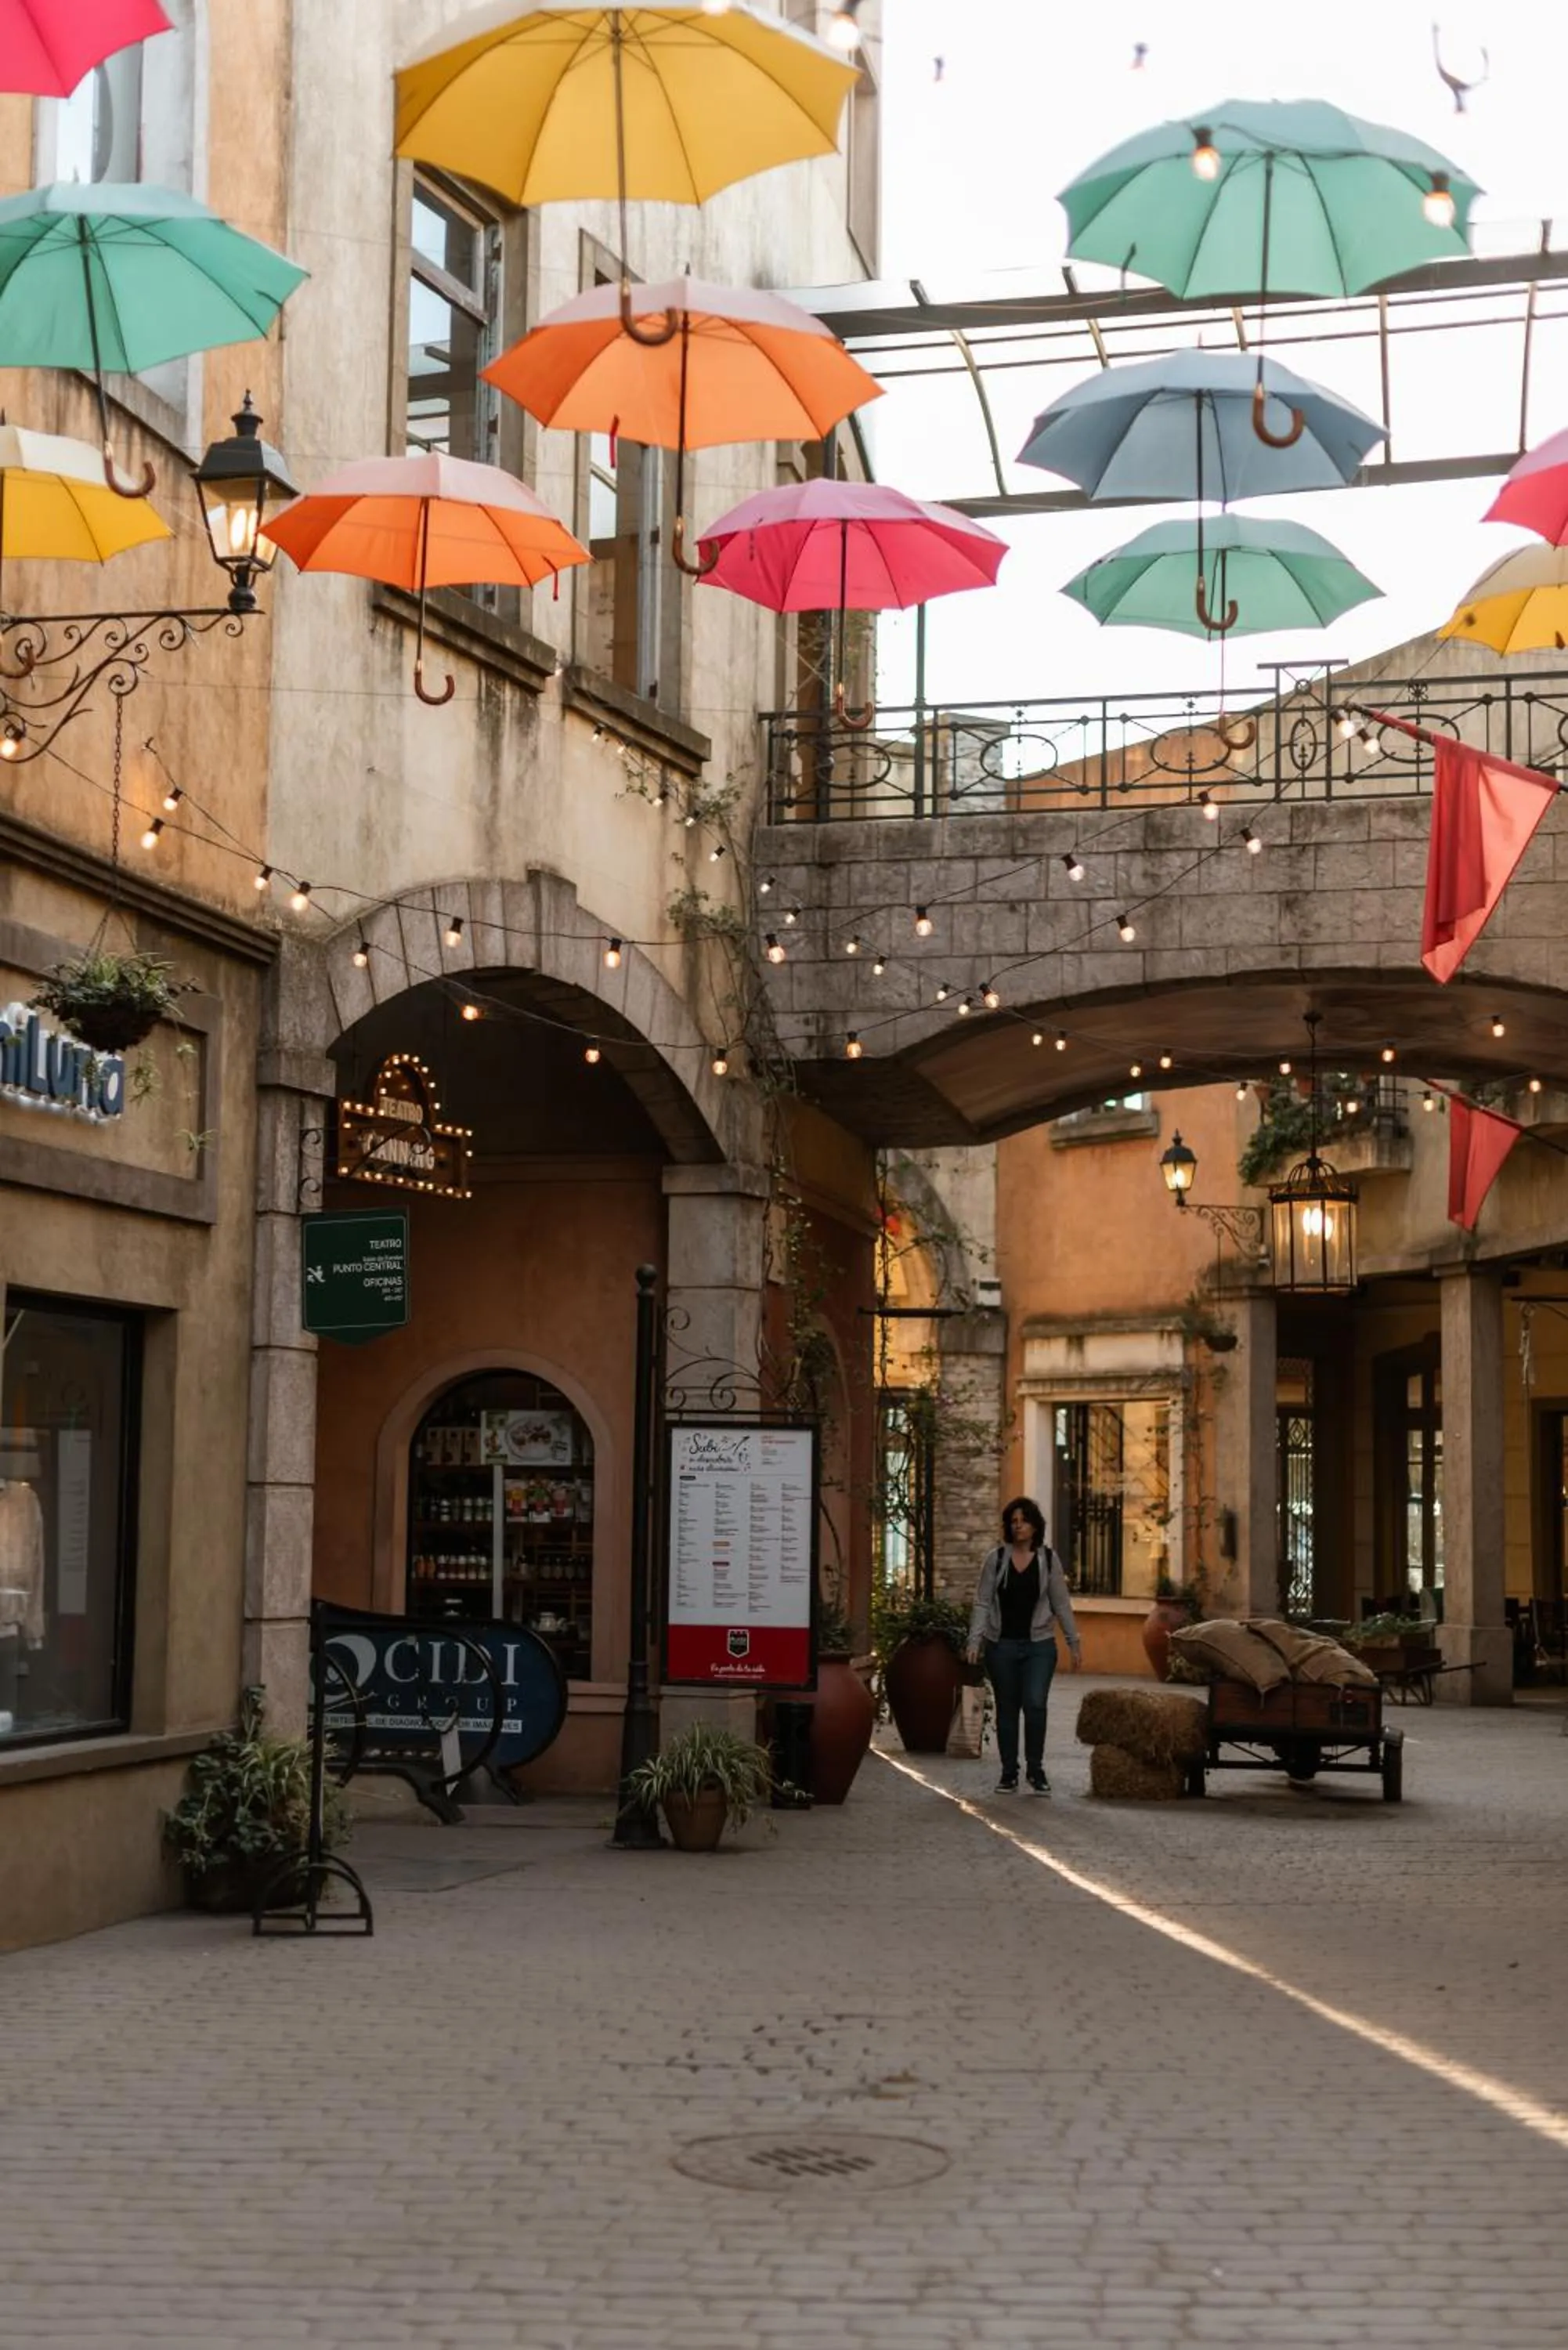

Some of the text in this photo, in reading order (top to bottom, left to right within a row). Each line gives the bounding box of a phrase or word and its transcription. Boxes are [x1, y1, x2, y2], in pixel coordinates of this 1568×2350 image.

[380, 1096, 424, 1125] TEATRO
[369, 1238, 403, 1249] TEATRO
[333, 1260, 402, 1274] PUNTO CENTRAL
[363, 1276, 403, 1288] OFICINAS
[384, 1637, 520, 1686] CIDI
